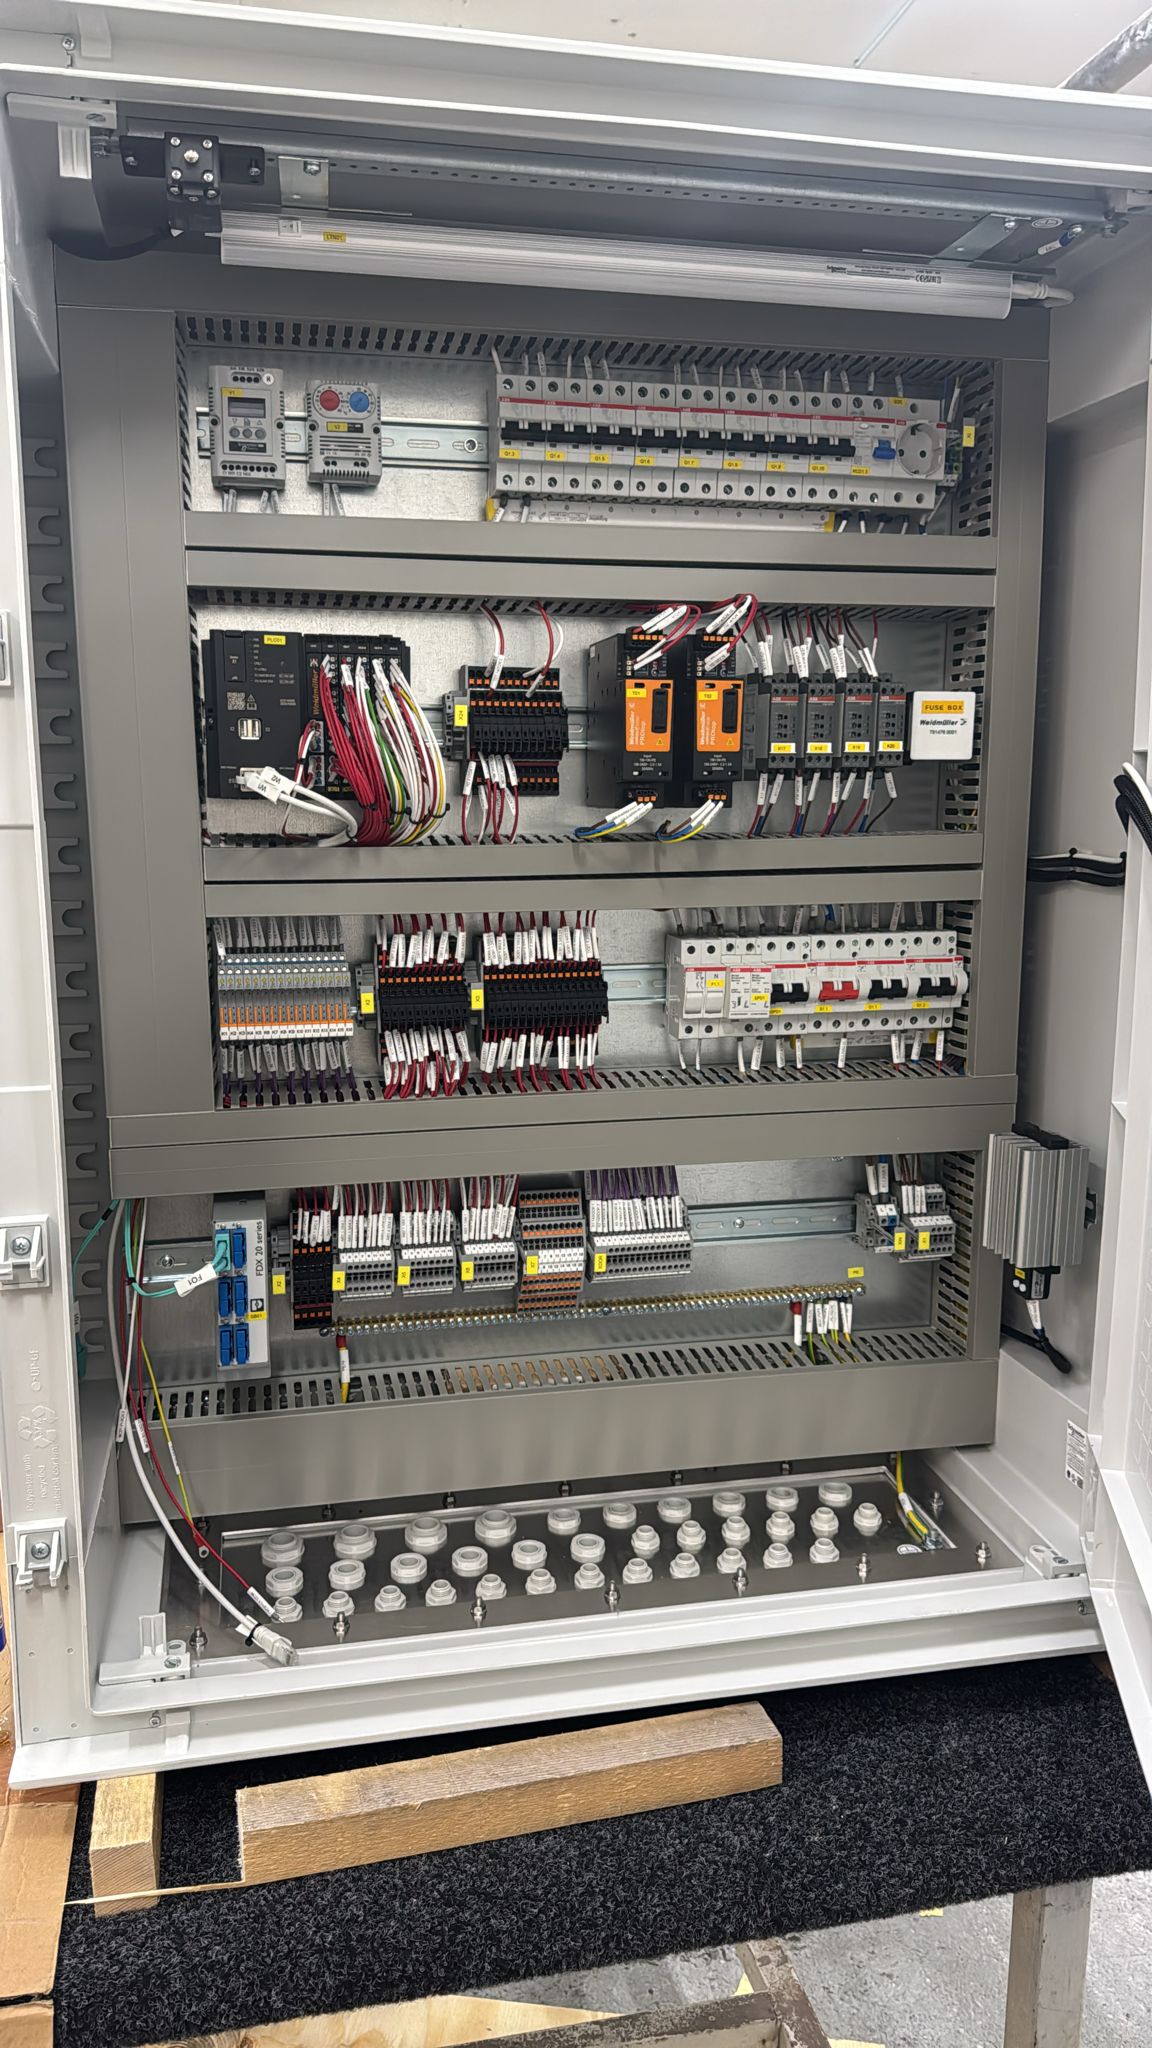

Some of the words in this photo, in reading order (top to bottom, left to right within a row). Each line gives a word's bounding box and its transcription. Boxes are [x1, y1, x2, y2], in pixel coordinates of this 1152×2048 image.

[920, 718, 958, 726] Weidmüller
[256, 1247, 264, 1258] 20
[256, 1260, 264, 1276] FDX
